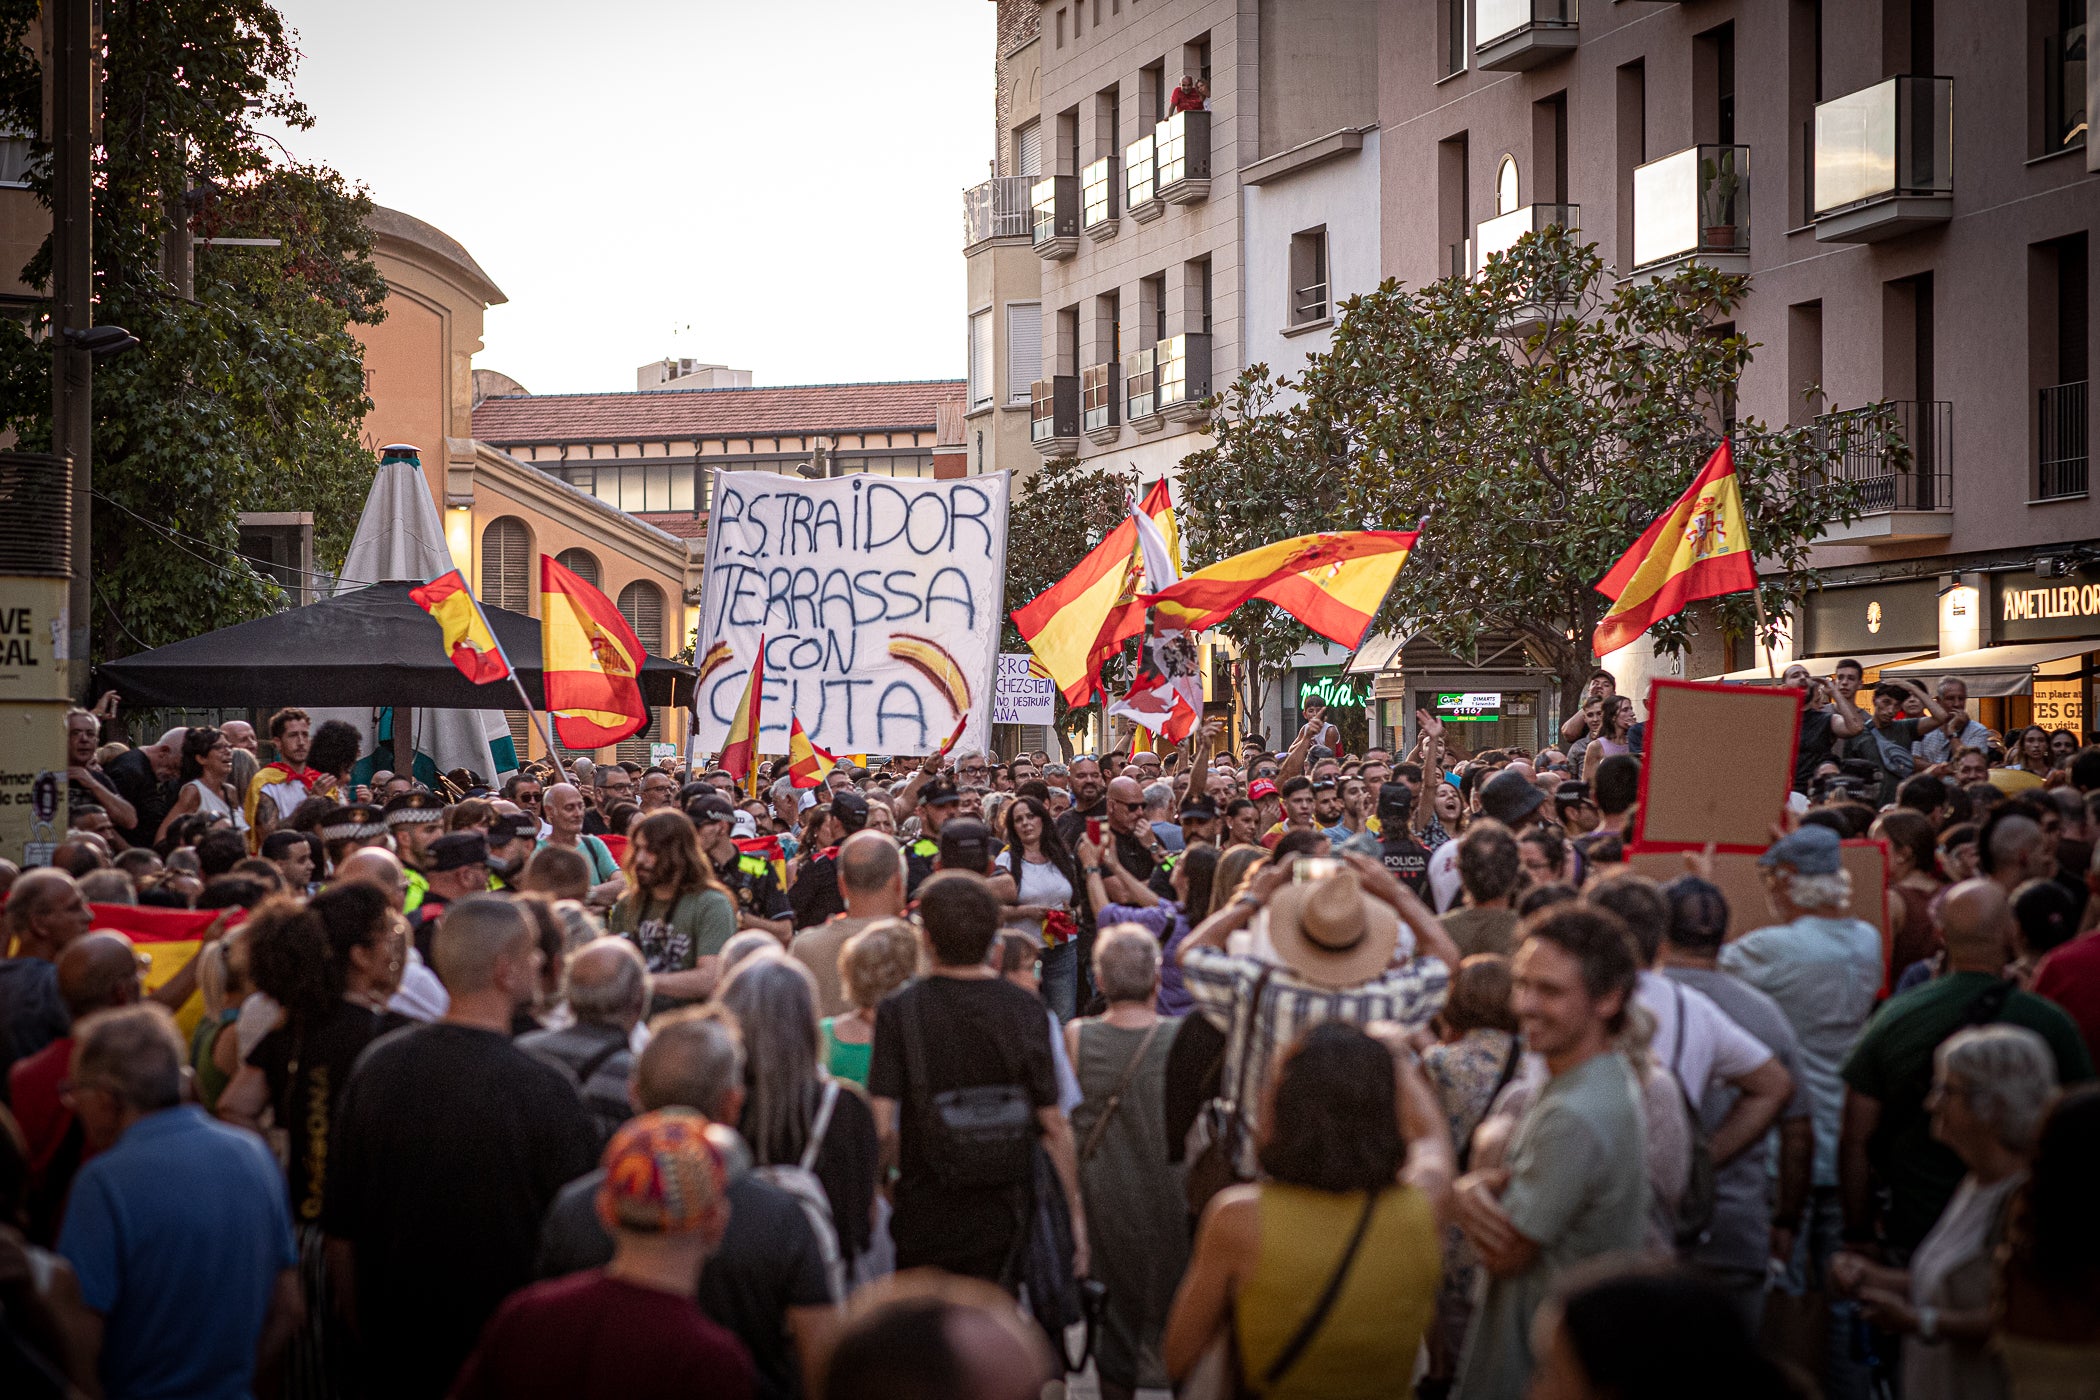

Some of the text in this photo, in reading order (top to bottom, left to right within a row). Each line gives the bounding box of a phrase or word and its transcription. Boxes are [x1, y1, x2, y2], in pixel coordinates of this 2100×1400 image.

[713, 563, 976, 637] TERRASSA
[765, 629, 857, 675] CON
[710, 670, 928, 748] CEUTA
[1454, 707, 1482, 715] 61167
[1384, 856, 1425, 866] POLICIA
